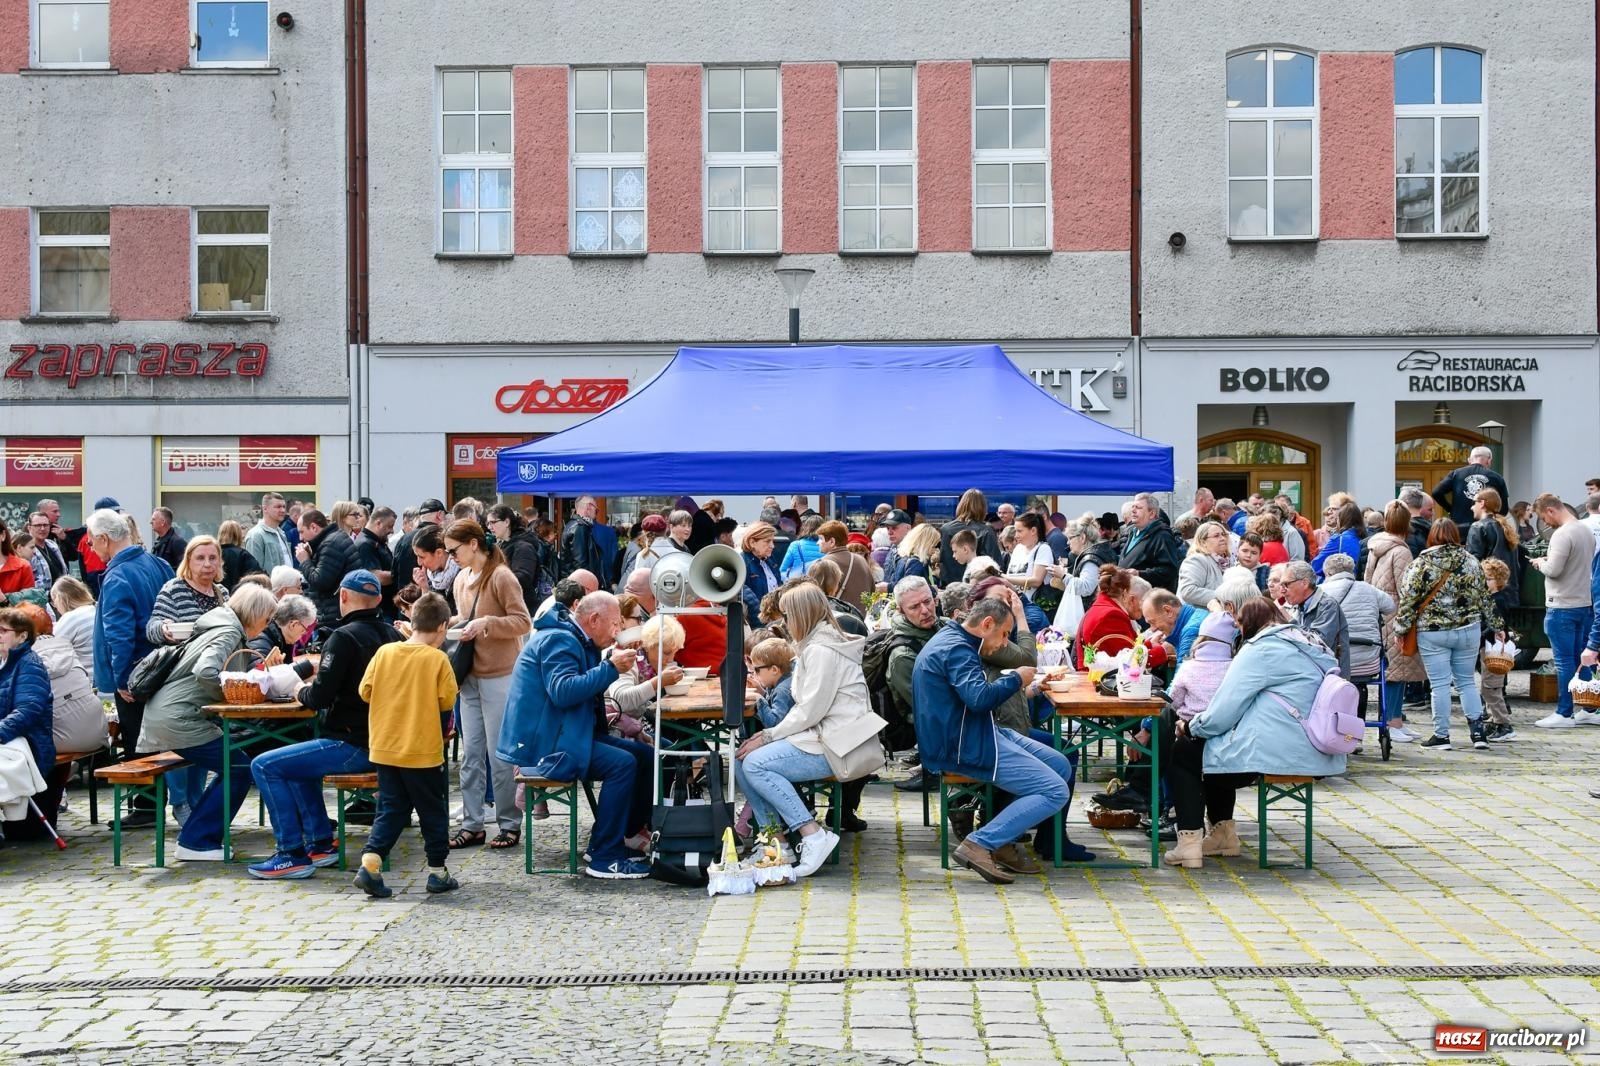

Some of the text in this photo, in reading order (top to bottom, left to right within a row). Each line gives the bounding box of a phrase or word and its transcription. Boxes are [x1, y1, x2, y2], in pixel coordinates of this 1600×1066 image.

[5, 342, 269, 389] zaprasza
[1442, 357, 1539, 372] RESTAURACJA
[1219, 366, 1330, 392] BOLKO
[1408, 374, 1526, 392] RACIBORSKA
[541, 463, 585, 472] Racibórz
[274, 860, 294, 871] HOKA
